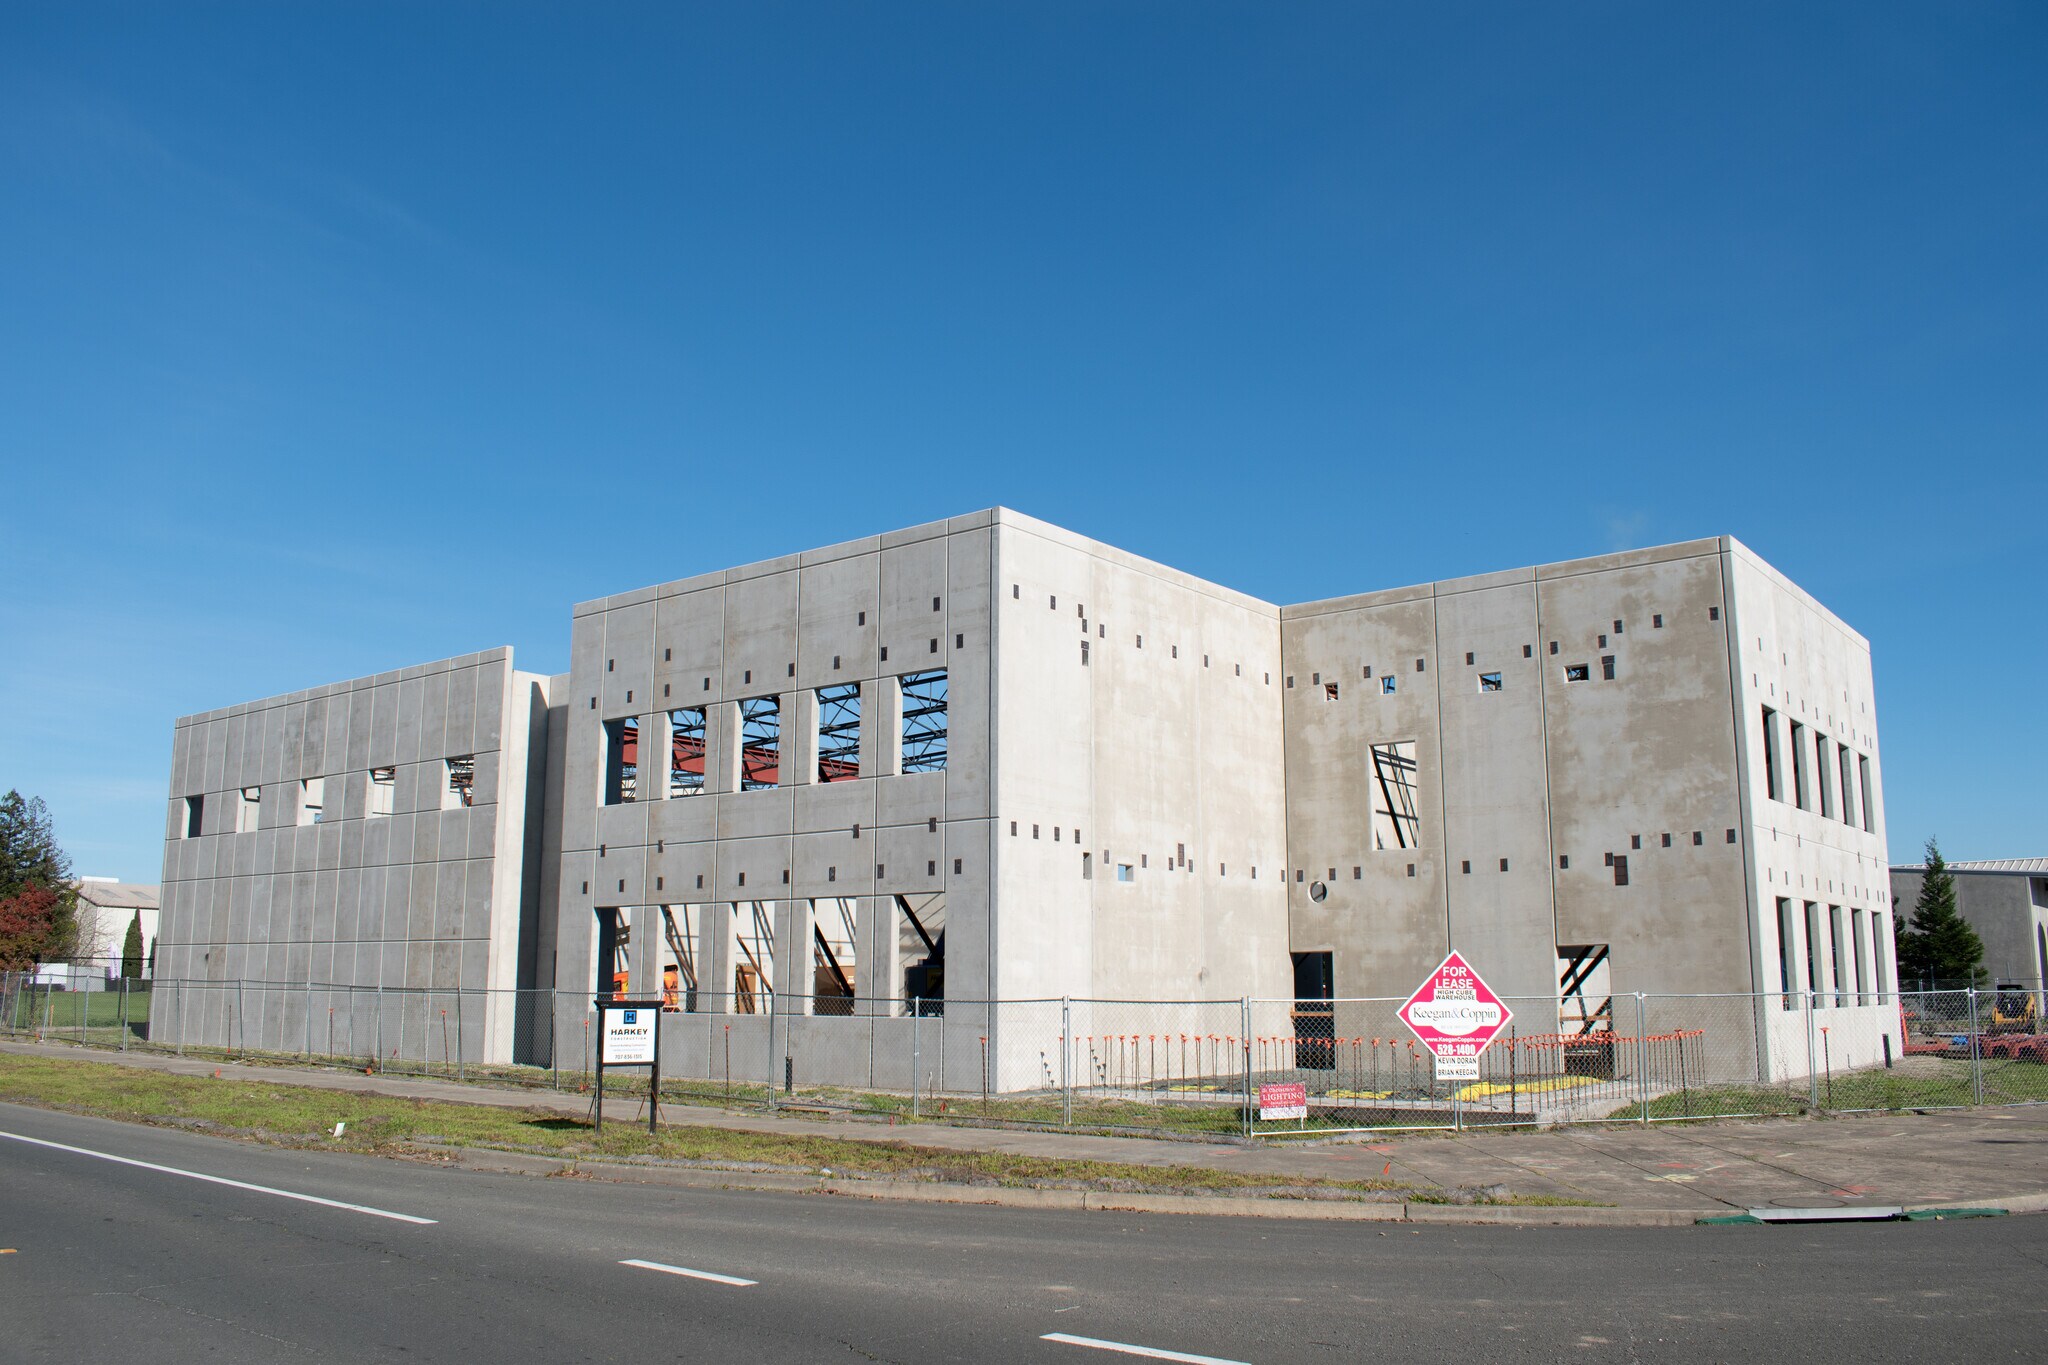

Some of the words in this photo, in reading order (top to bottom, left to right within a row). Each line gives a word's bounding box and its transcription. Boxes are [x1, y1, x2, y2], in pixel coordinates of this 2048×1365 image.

[1443, 966, 1467, 977] FOR
[1435, 978, 1474, 989] LEASE
[1437, 1044, 1476, 1055] 528-1400
[1262, 1092, 1303, 1101] LIGHTING
